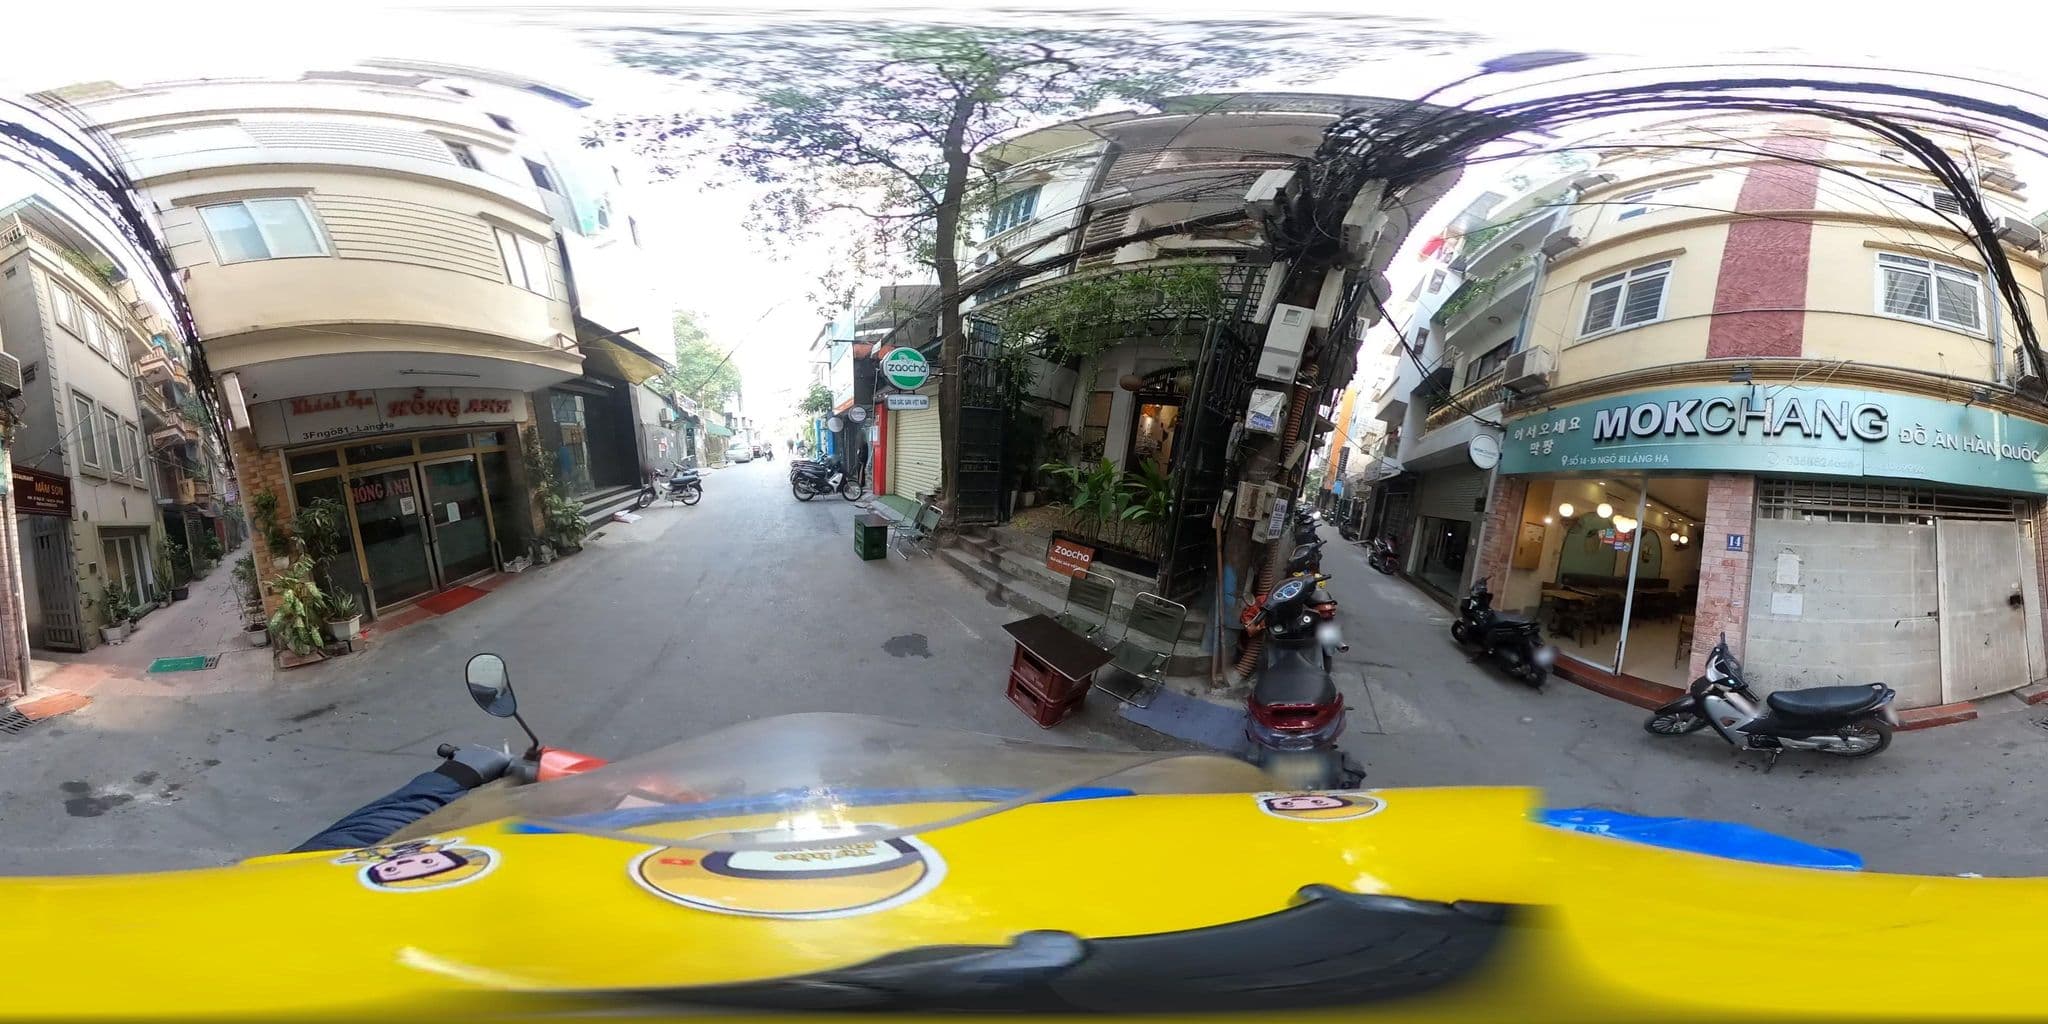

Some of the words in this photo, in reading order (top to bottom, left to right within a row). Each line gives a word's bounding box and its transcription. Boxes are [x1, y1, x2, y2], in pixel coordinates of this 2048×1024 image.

[1592, 396, 1890, 441] MOKCHANG
[1898, 423, 1928, 445] ĐỒ
[1933, 429, 1958, 450] ĂN
[1962, 435, 1997, 456] HÀN
[1055, 545, 1089, 561] zaocha
[1729, 536, 1741, 547] 14
